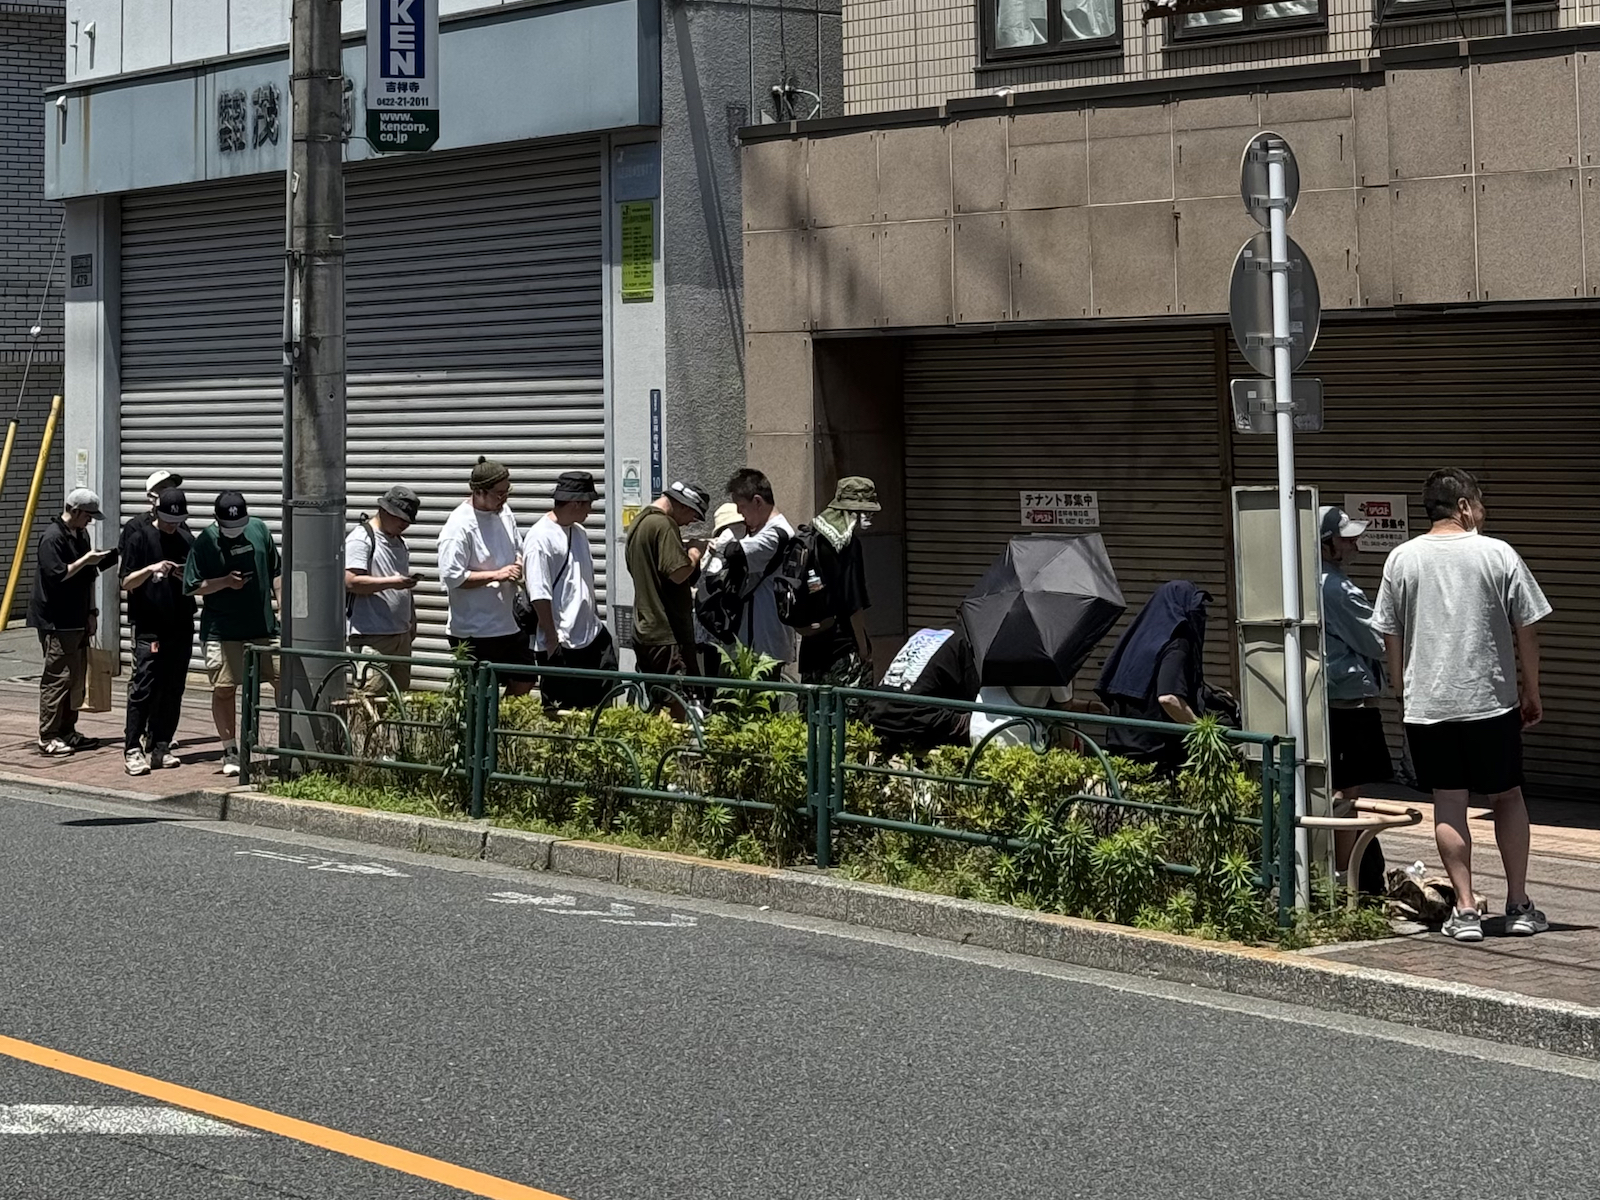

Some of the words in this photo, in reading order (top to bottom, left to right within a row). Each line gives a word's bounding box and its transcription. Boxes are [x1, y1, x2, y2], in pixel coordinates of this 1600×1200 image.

[389, 0, 416, 76] KEN
[385, 81, 420, 94] 吉祥寺
[376, 96, 429, 107] 0422-21-2011
[379, 113, 414, 122] www.
[379, 121, 430, 134] kencorp.
[379, 131, 408, 144] co.jp
[1025, 494, 1092, 506] テナント募集中
